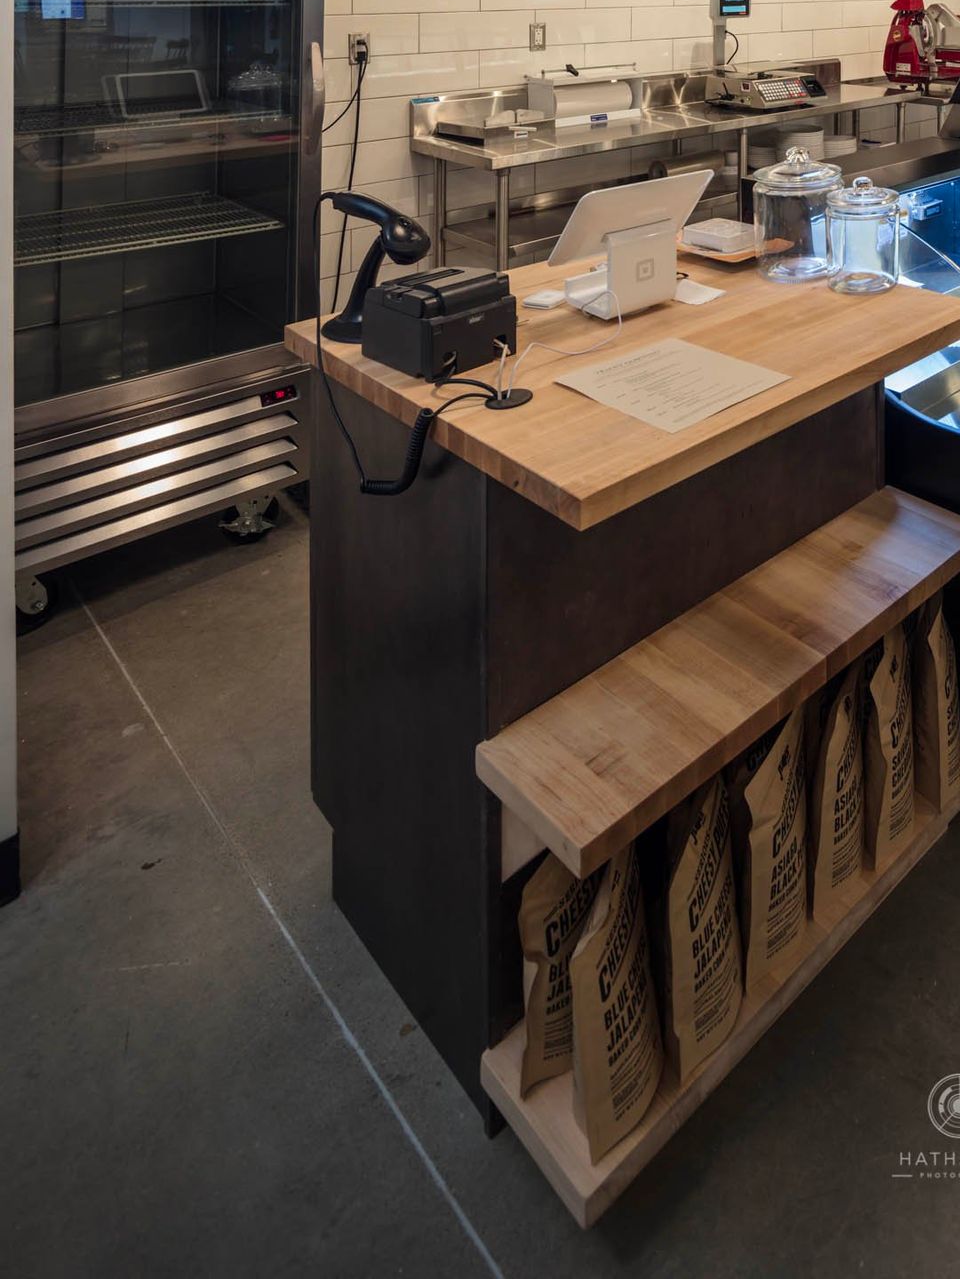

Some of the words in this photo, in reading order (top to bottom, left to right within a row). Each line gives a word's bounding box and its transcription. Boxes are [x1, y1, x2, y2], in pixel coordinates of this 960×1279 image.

[769, 861, 798, 901] BLACK
[771, 835, 798, 883] ASIAGO
[688, 840, 722, 933] CHEESY
[692, 915, 716, 959] BLUE
[604, 981, 629, 1030] BLUE
